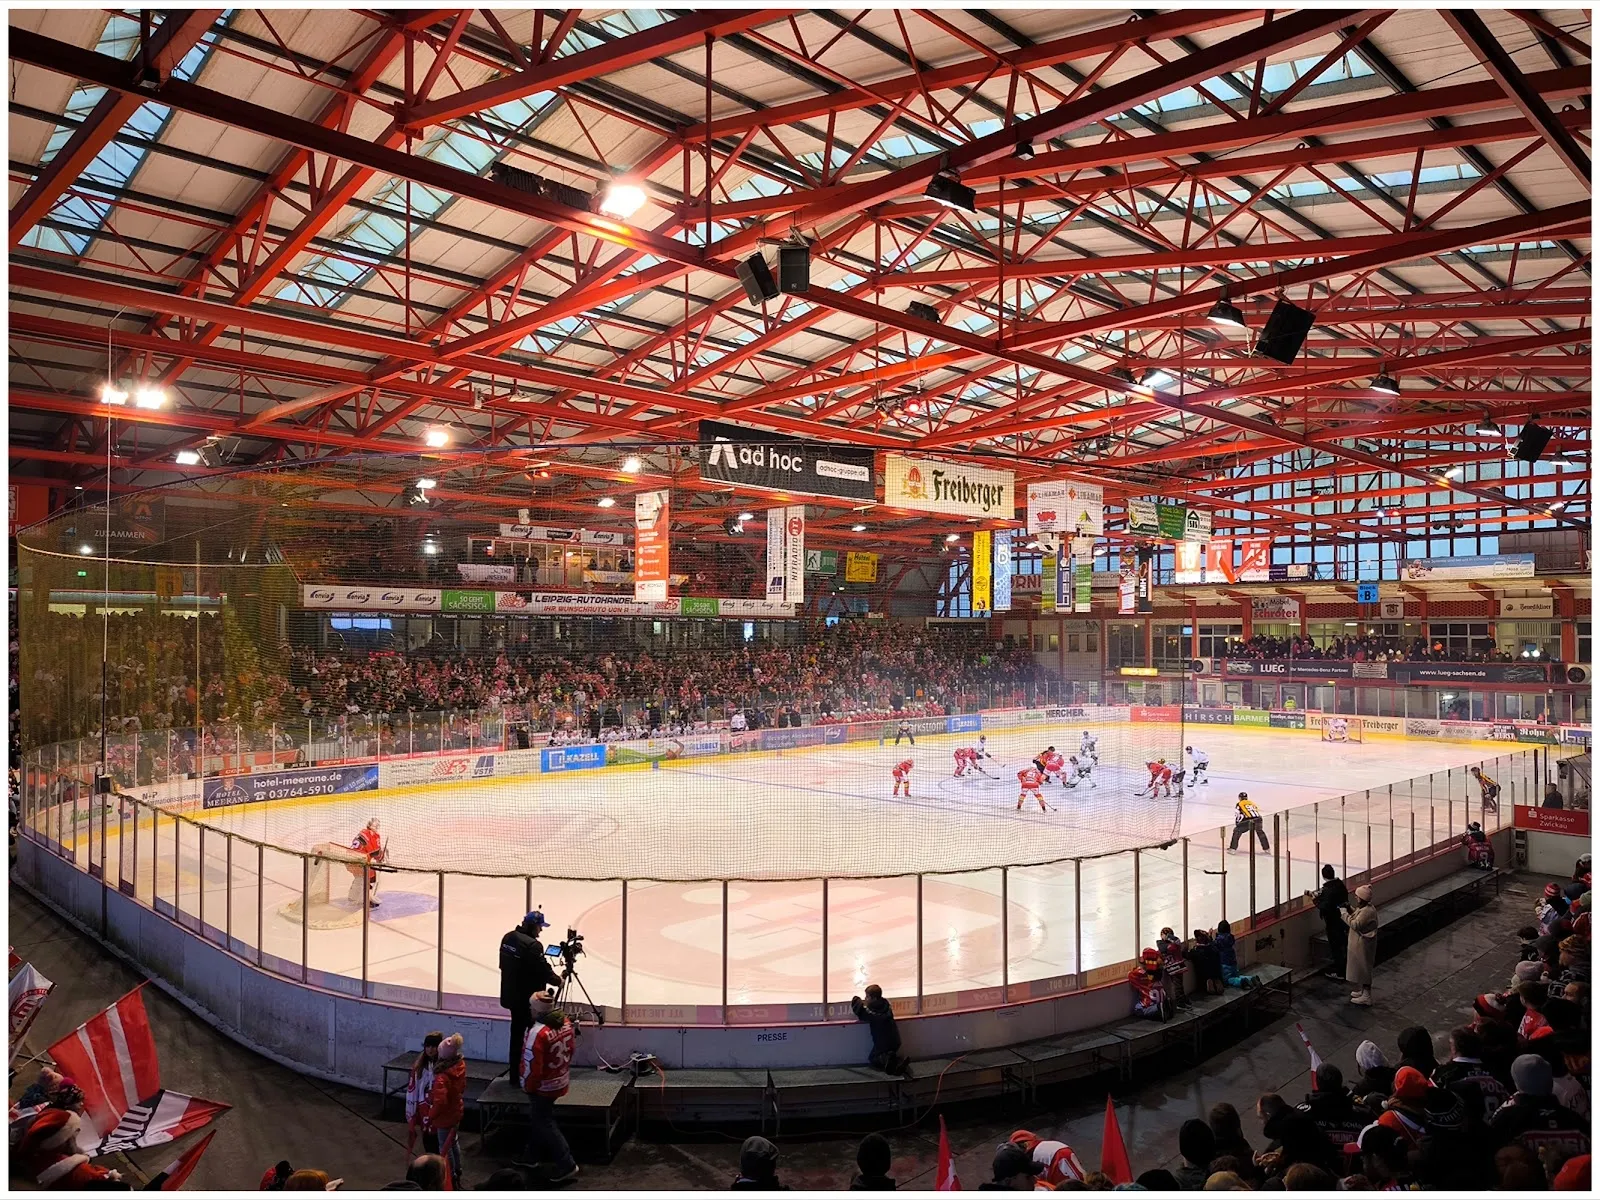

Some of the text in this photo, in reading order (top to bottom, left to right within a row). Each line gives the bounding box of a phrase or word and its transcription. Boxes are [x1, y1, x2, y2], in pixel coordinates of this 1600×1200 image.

[740, 445, 803, 472] ad hoc
[932, 469, 1004, 512] Freiberger
[1364, 591, 1371, 601] B
[557, 605, 606, 613] WUNSCHAUTO
[1260, 664, 1285, 673] LUEG
[1420, 669, 1486, 677] www.lueg-sachsen.de
[1046, 708, 1084, 718] HERCHER
[1234, 714, 1270, 723] BARMER
[1362, 719, 1399, 731] Freiberger
[253, 772, 342, 789] hotel-meerane.de
[268, 785, 334, 799] 03764-5910
[207, 795, 250, 807] MEERANE
[1540, 813, 1575, 823] Sparkasse
[1540, 820, 1568, 829] Zwickau
[757, 1032, 788, 1042] PRESSE
[548, 1035, 573, 1069] 35
